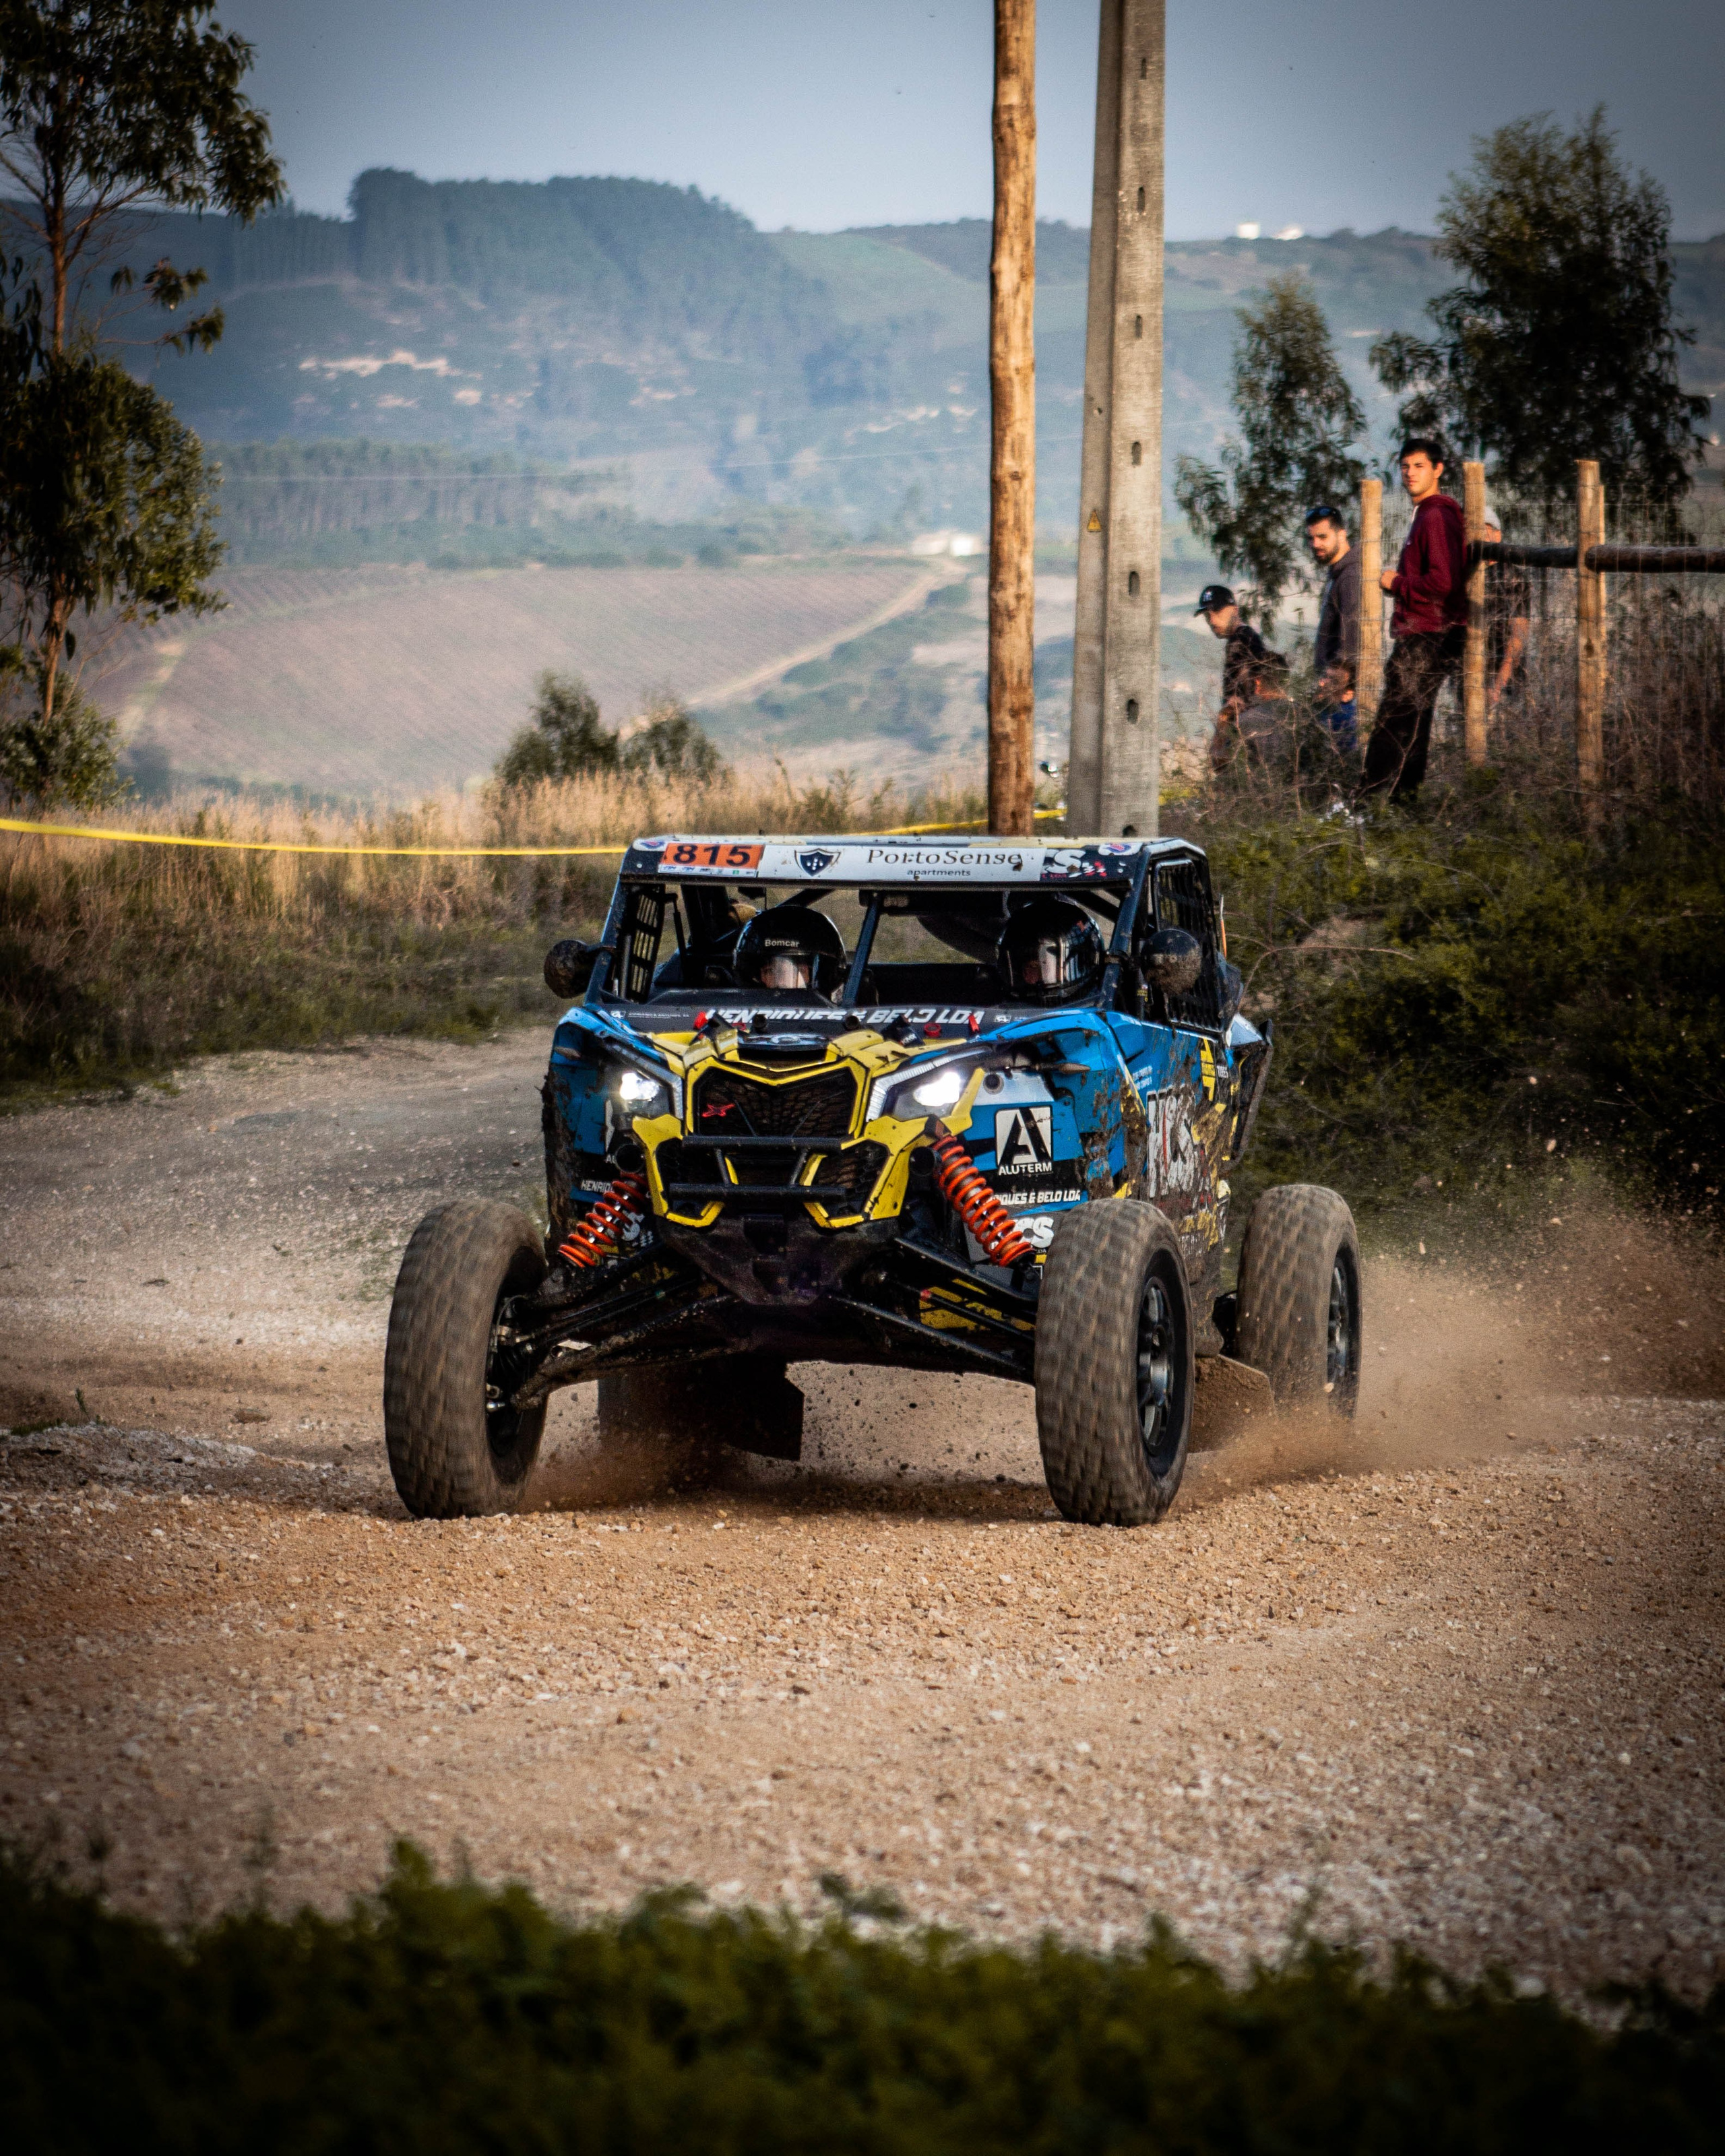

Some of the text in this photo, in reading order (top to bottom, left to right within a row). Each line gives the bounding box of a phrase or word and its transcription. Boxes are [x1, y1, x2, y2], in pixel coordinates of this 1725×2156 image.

[672, 844, 753, 866] 815
[867, 849, 1022, 864] PortoSense
[907, 868, 972, 878] apartments
[999, 1162, 1053, 1176] ALUTERM
[1036, 1192, 1063, 1203] BELO
[1063, 1189, 1081, 1202] LDA
